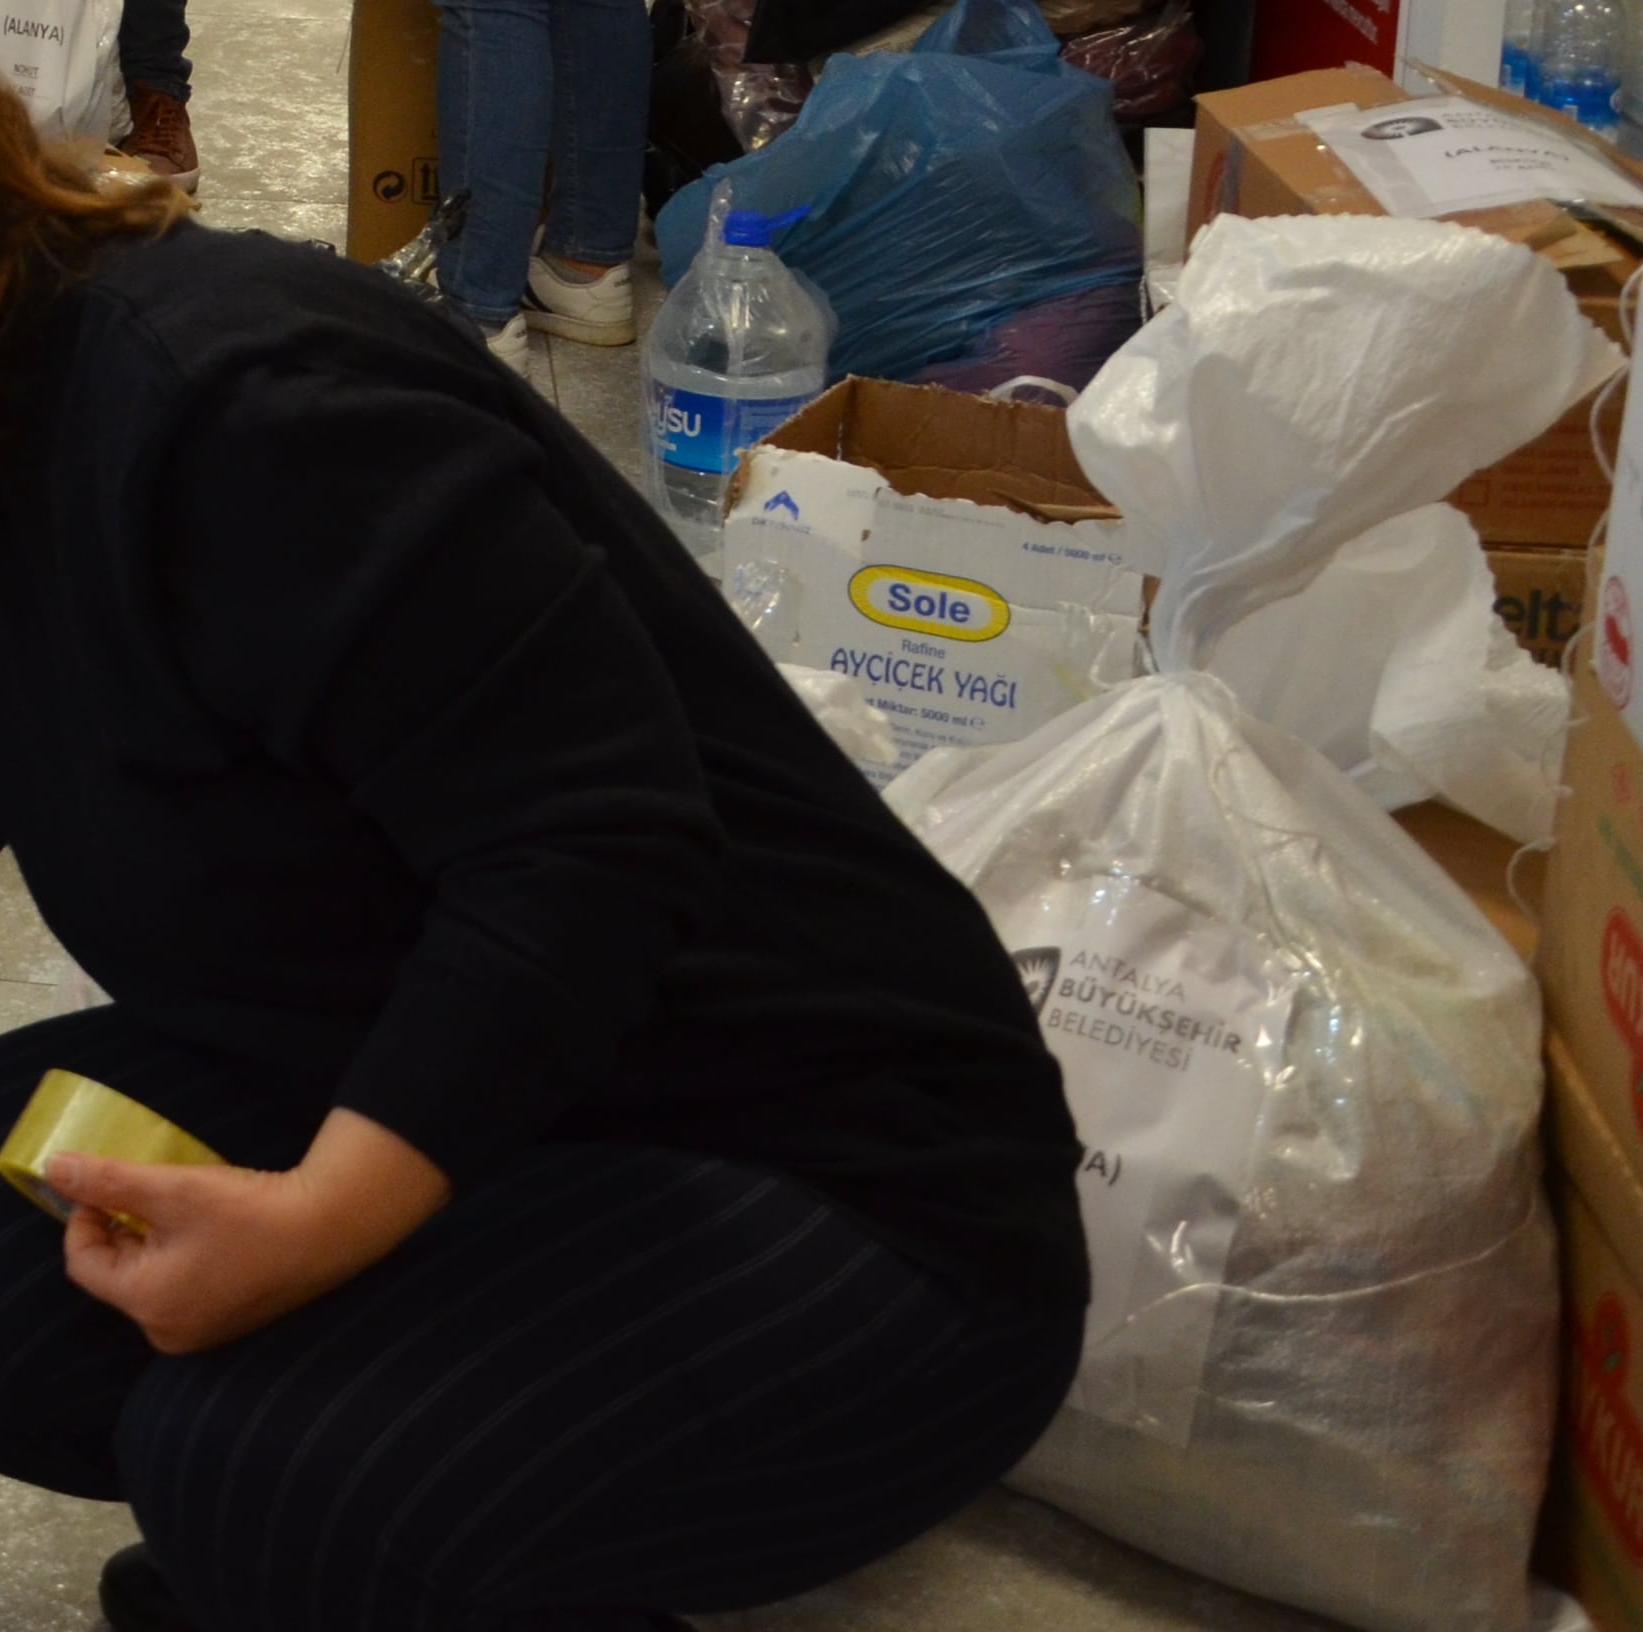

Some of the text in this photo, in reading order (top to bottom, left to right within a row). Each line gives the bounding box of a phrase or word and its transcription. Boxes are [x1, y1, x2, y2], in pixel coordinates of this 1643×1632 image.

[3, 14, 65, 47] (ALANYA)
[887, 582, 972, 624] Sole
[900, 638, 947, 659] Rafine
[830, 646, 1018, 709] AYÇİÇEK YAĞI
[920, 707, 951, 722] 5000
[952, 712, 969, 727] ml
[1069, 948, 1187, 1003] ANTALYA
[1057, 974, 1243, 1055] BÜYÜKŞEHİR
[1046, 1008, 1194, 1072] BELEDİYESİ
